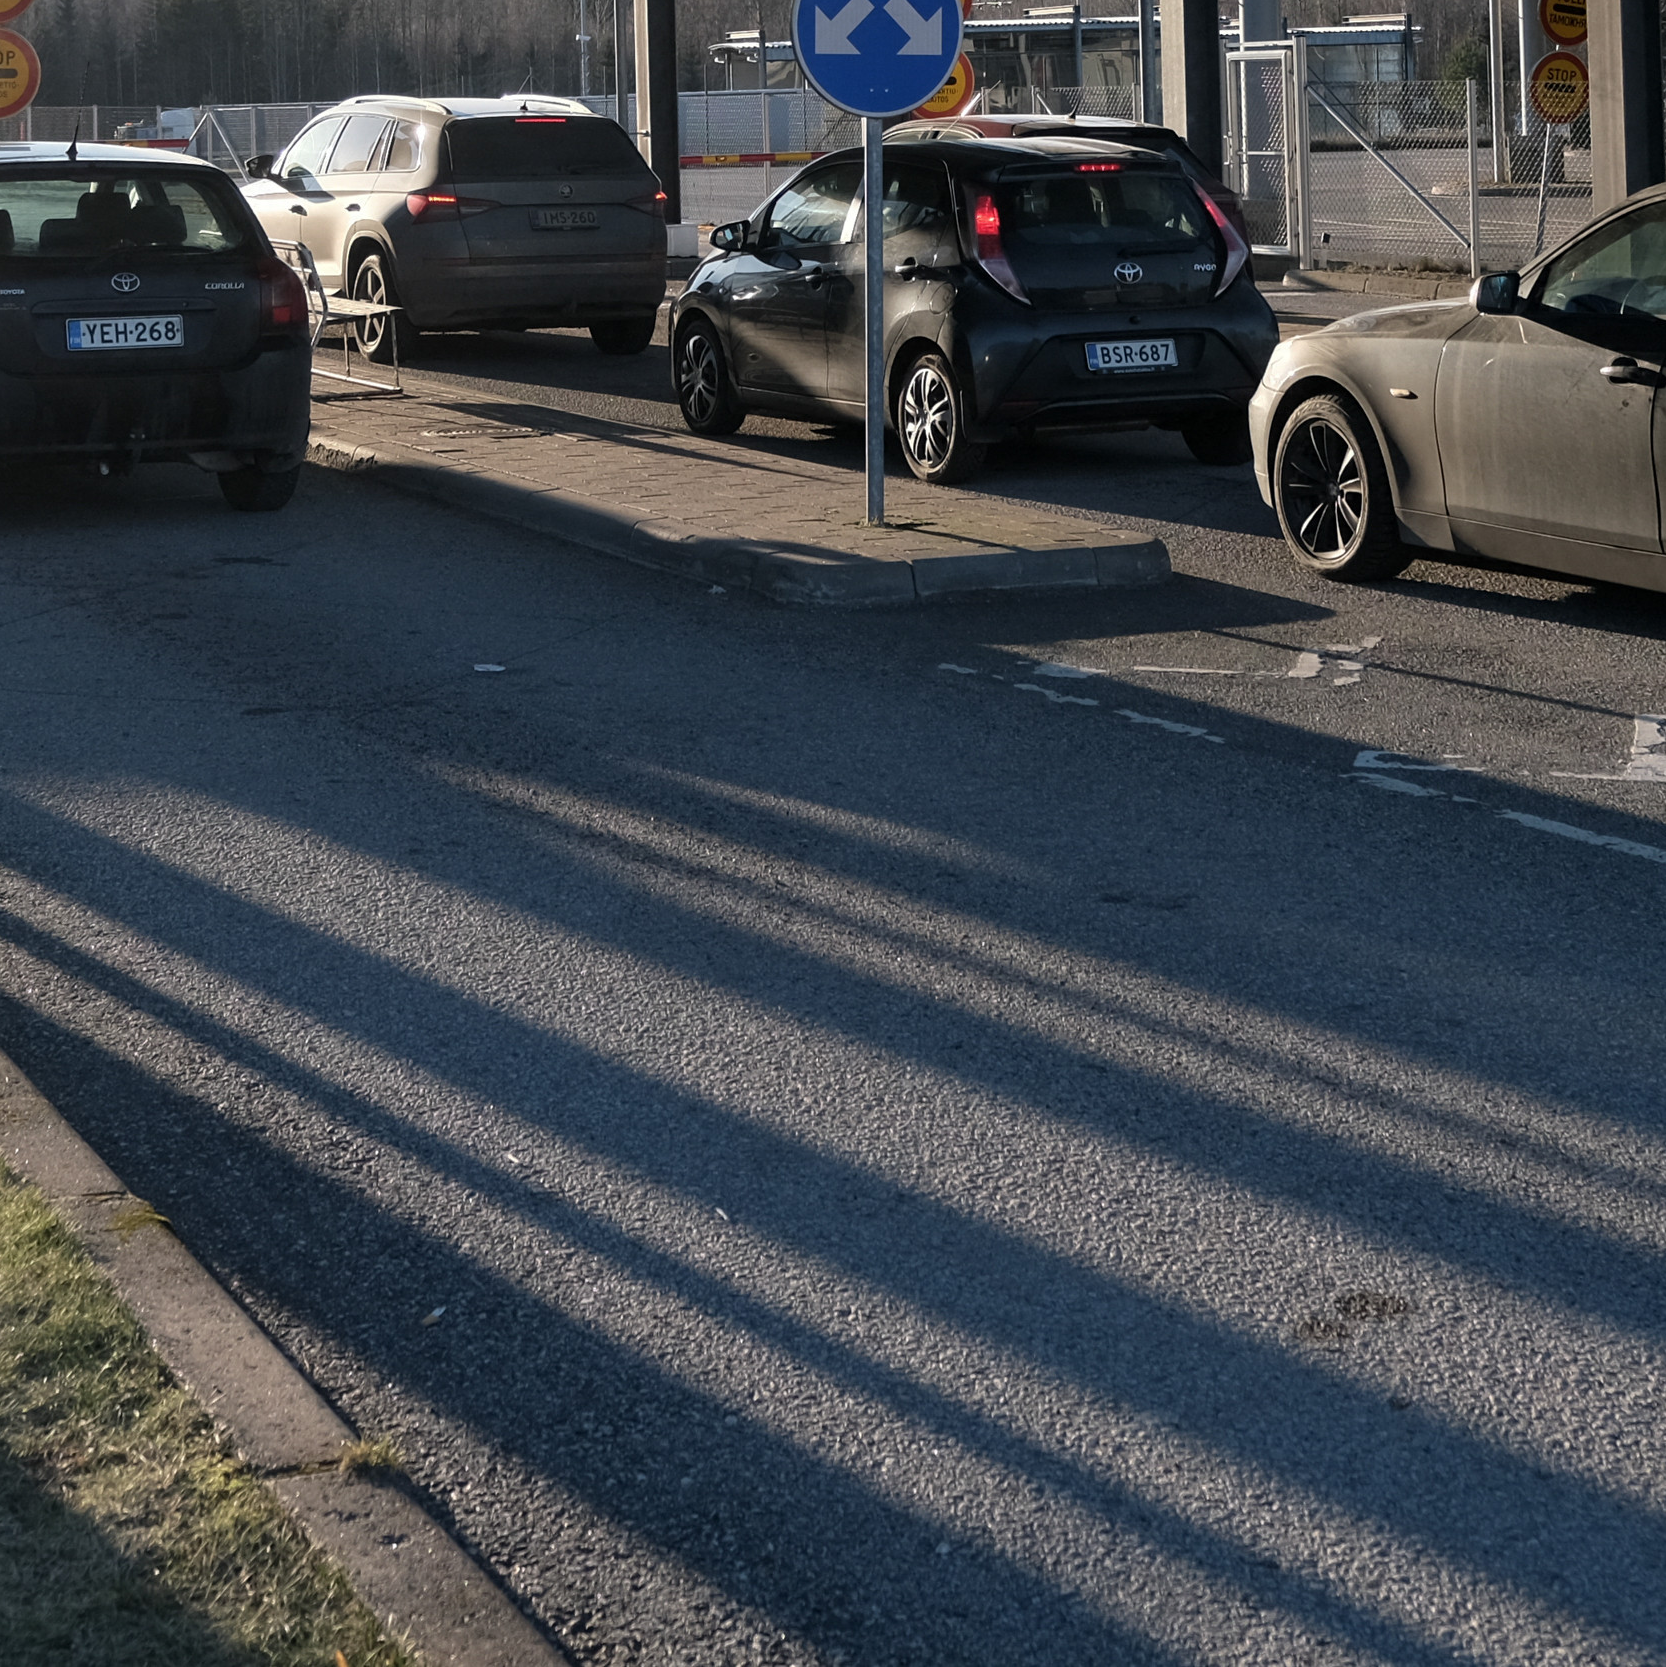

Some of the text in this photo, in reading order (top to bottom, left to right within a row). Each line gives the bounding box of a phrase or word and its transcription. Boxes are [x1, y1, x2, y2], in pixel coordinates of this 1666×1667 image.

[1547, 68, 1577, 82] STOP
[204, 281, 245, 291] COROLLA
[85, 321, 177, 344] YEH-268
[1100, 344, 1170, 365] BSR-687
